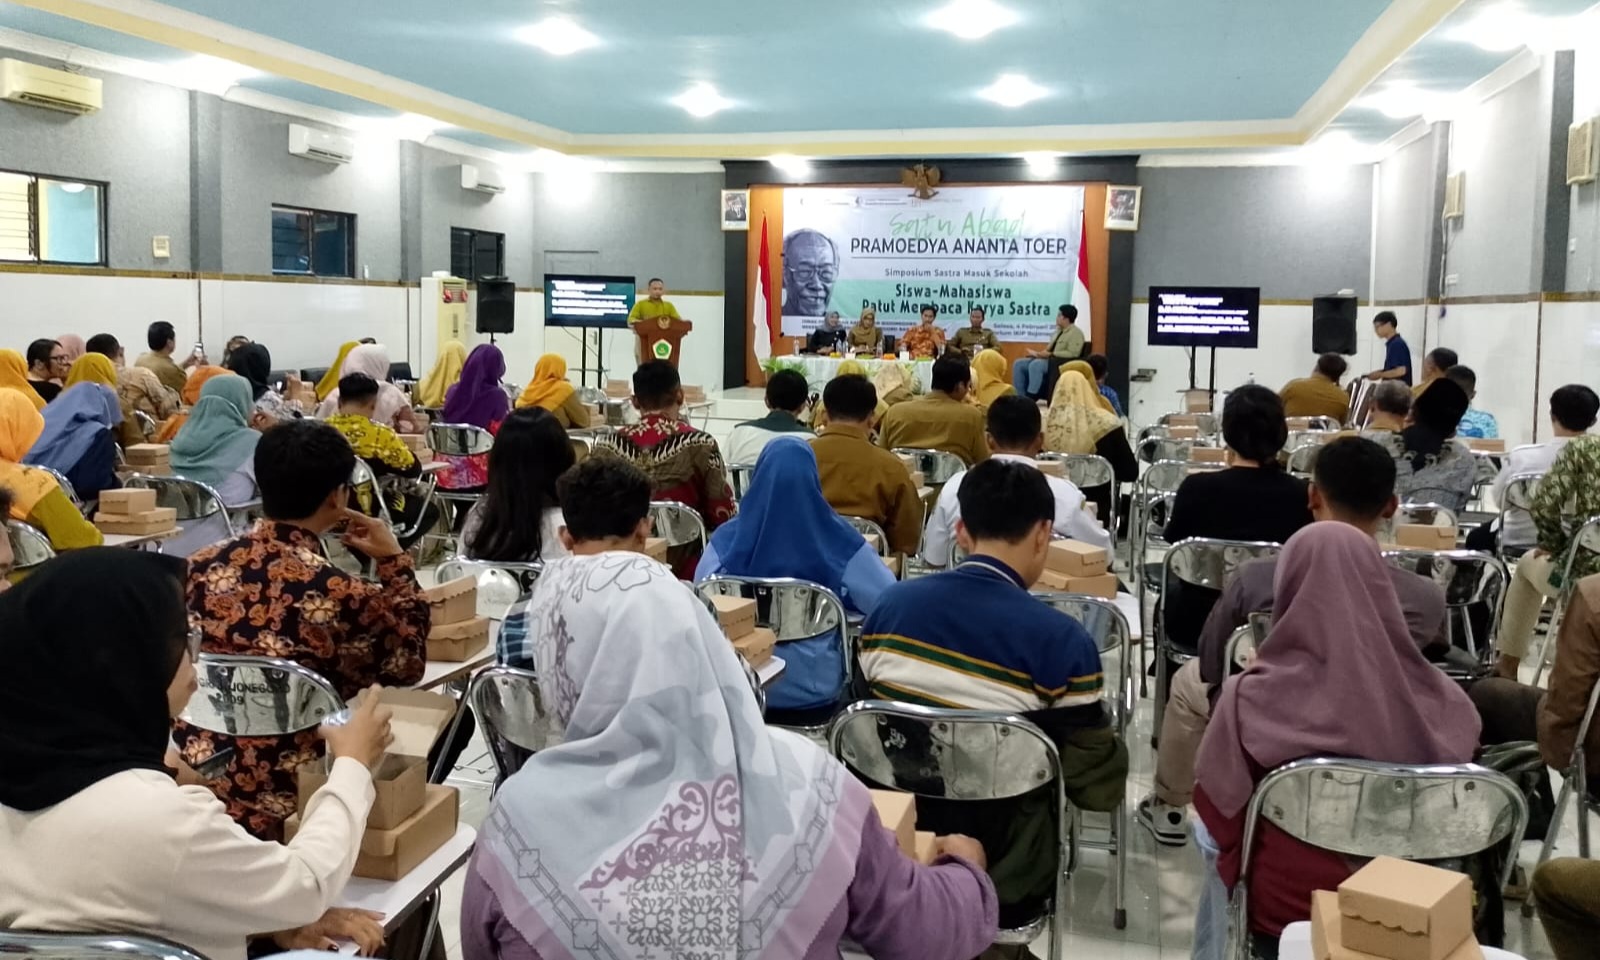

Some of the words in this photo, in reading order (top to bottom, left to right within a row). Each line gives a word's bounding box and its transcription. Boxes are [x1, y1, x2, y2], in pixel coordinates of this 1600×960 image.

[850, 237, 949, 254] PRAMOEDYA
[952, 238, 1019, 254] ANANTA
[1023, 238, 1067, 254] TOER
[885, 268, 931, 278] Simposium
[934, 269, 961, 278] Sastra
[964, 269, 991, 278] Masuk
[993, 269, 1029, 278] Sekolah
[895, 283, 1012, 299] Siswa-Mahasiswa
[1009, 301, 1051, 316] Sastra
